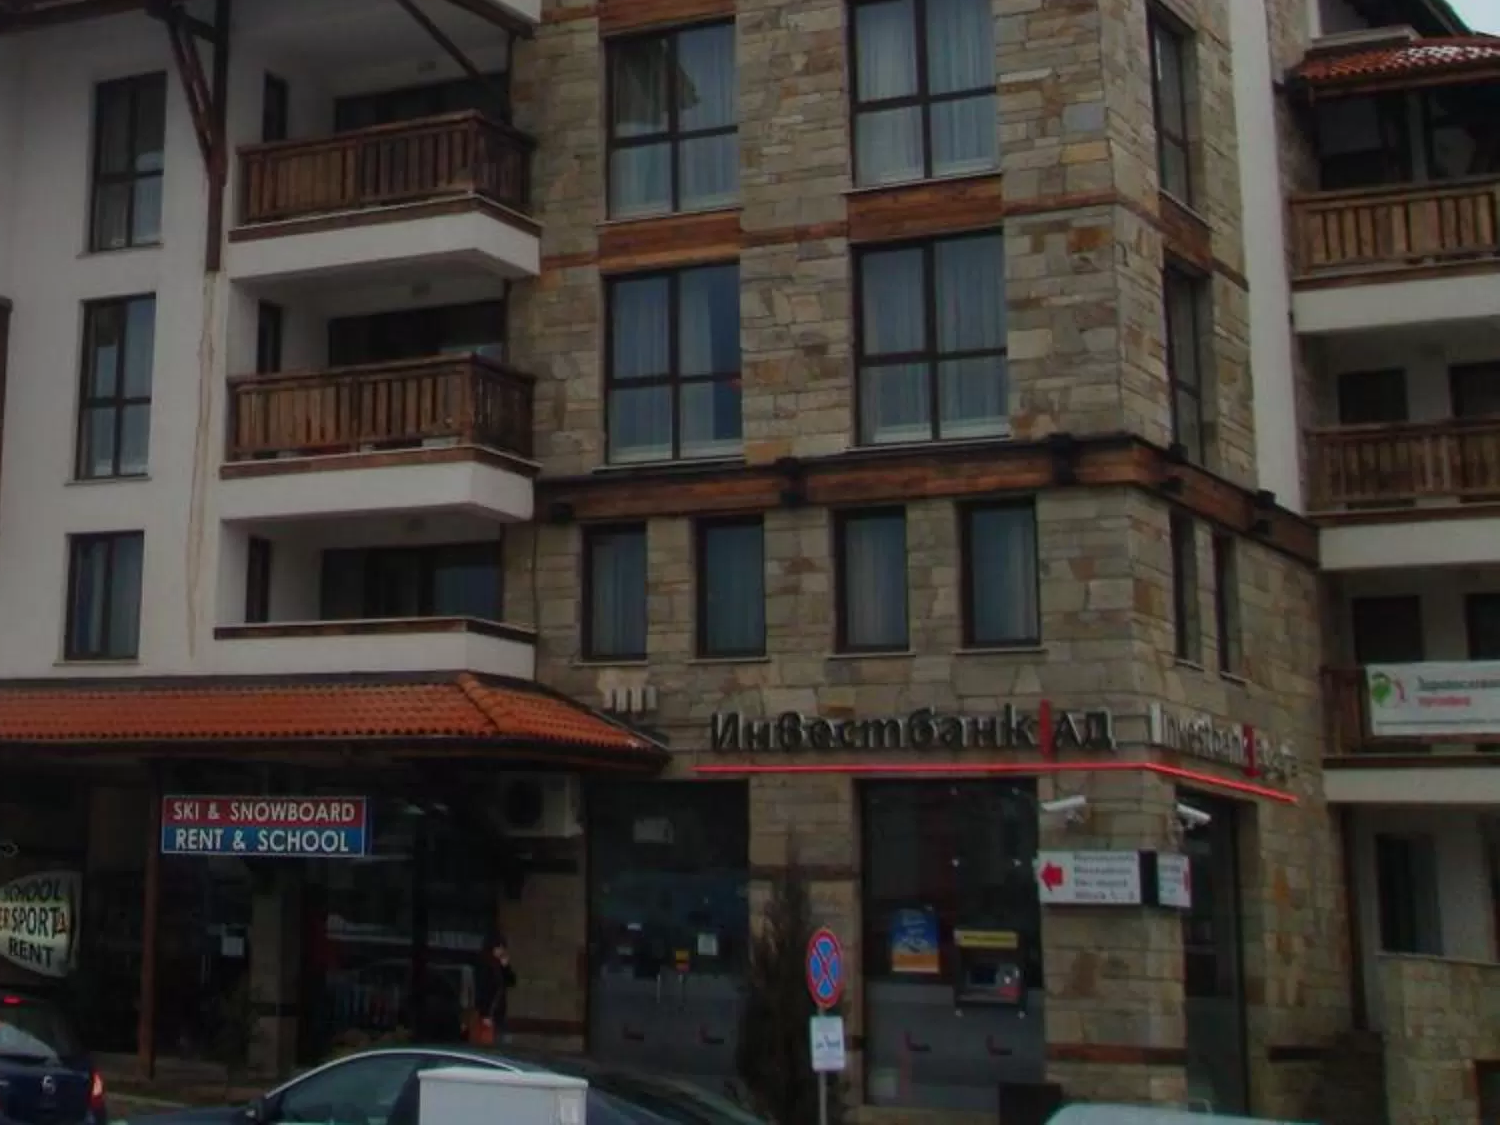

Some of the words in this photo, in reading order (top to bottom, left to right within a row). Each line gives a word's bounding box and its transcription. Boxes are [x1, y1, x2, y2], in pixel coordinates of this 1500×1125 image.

[173, 801, 199, 820] SKI
[207, 801, 220, 820] &
[230, 801, 355, 821] SNOWBOARD
[175, 828, 224, 851] RENT
[232, 830, 246, 851] &
[257, 829, 349, 853] SCHOOL
[1, 878, 62, 903] SCHOOL
[8, 936, 55, 968] RENT
